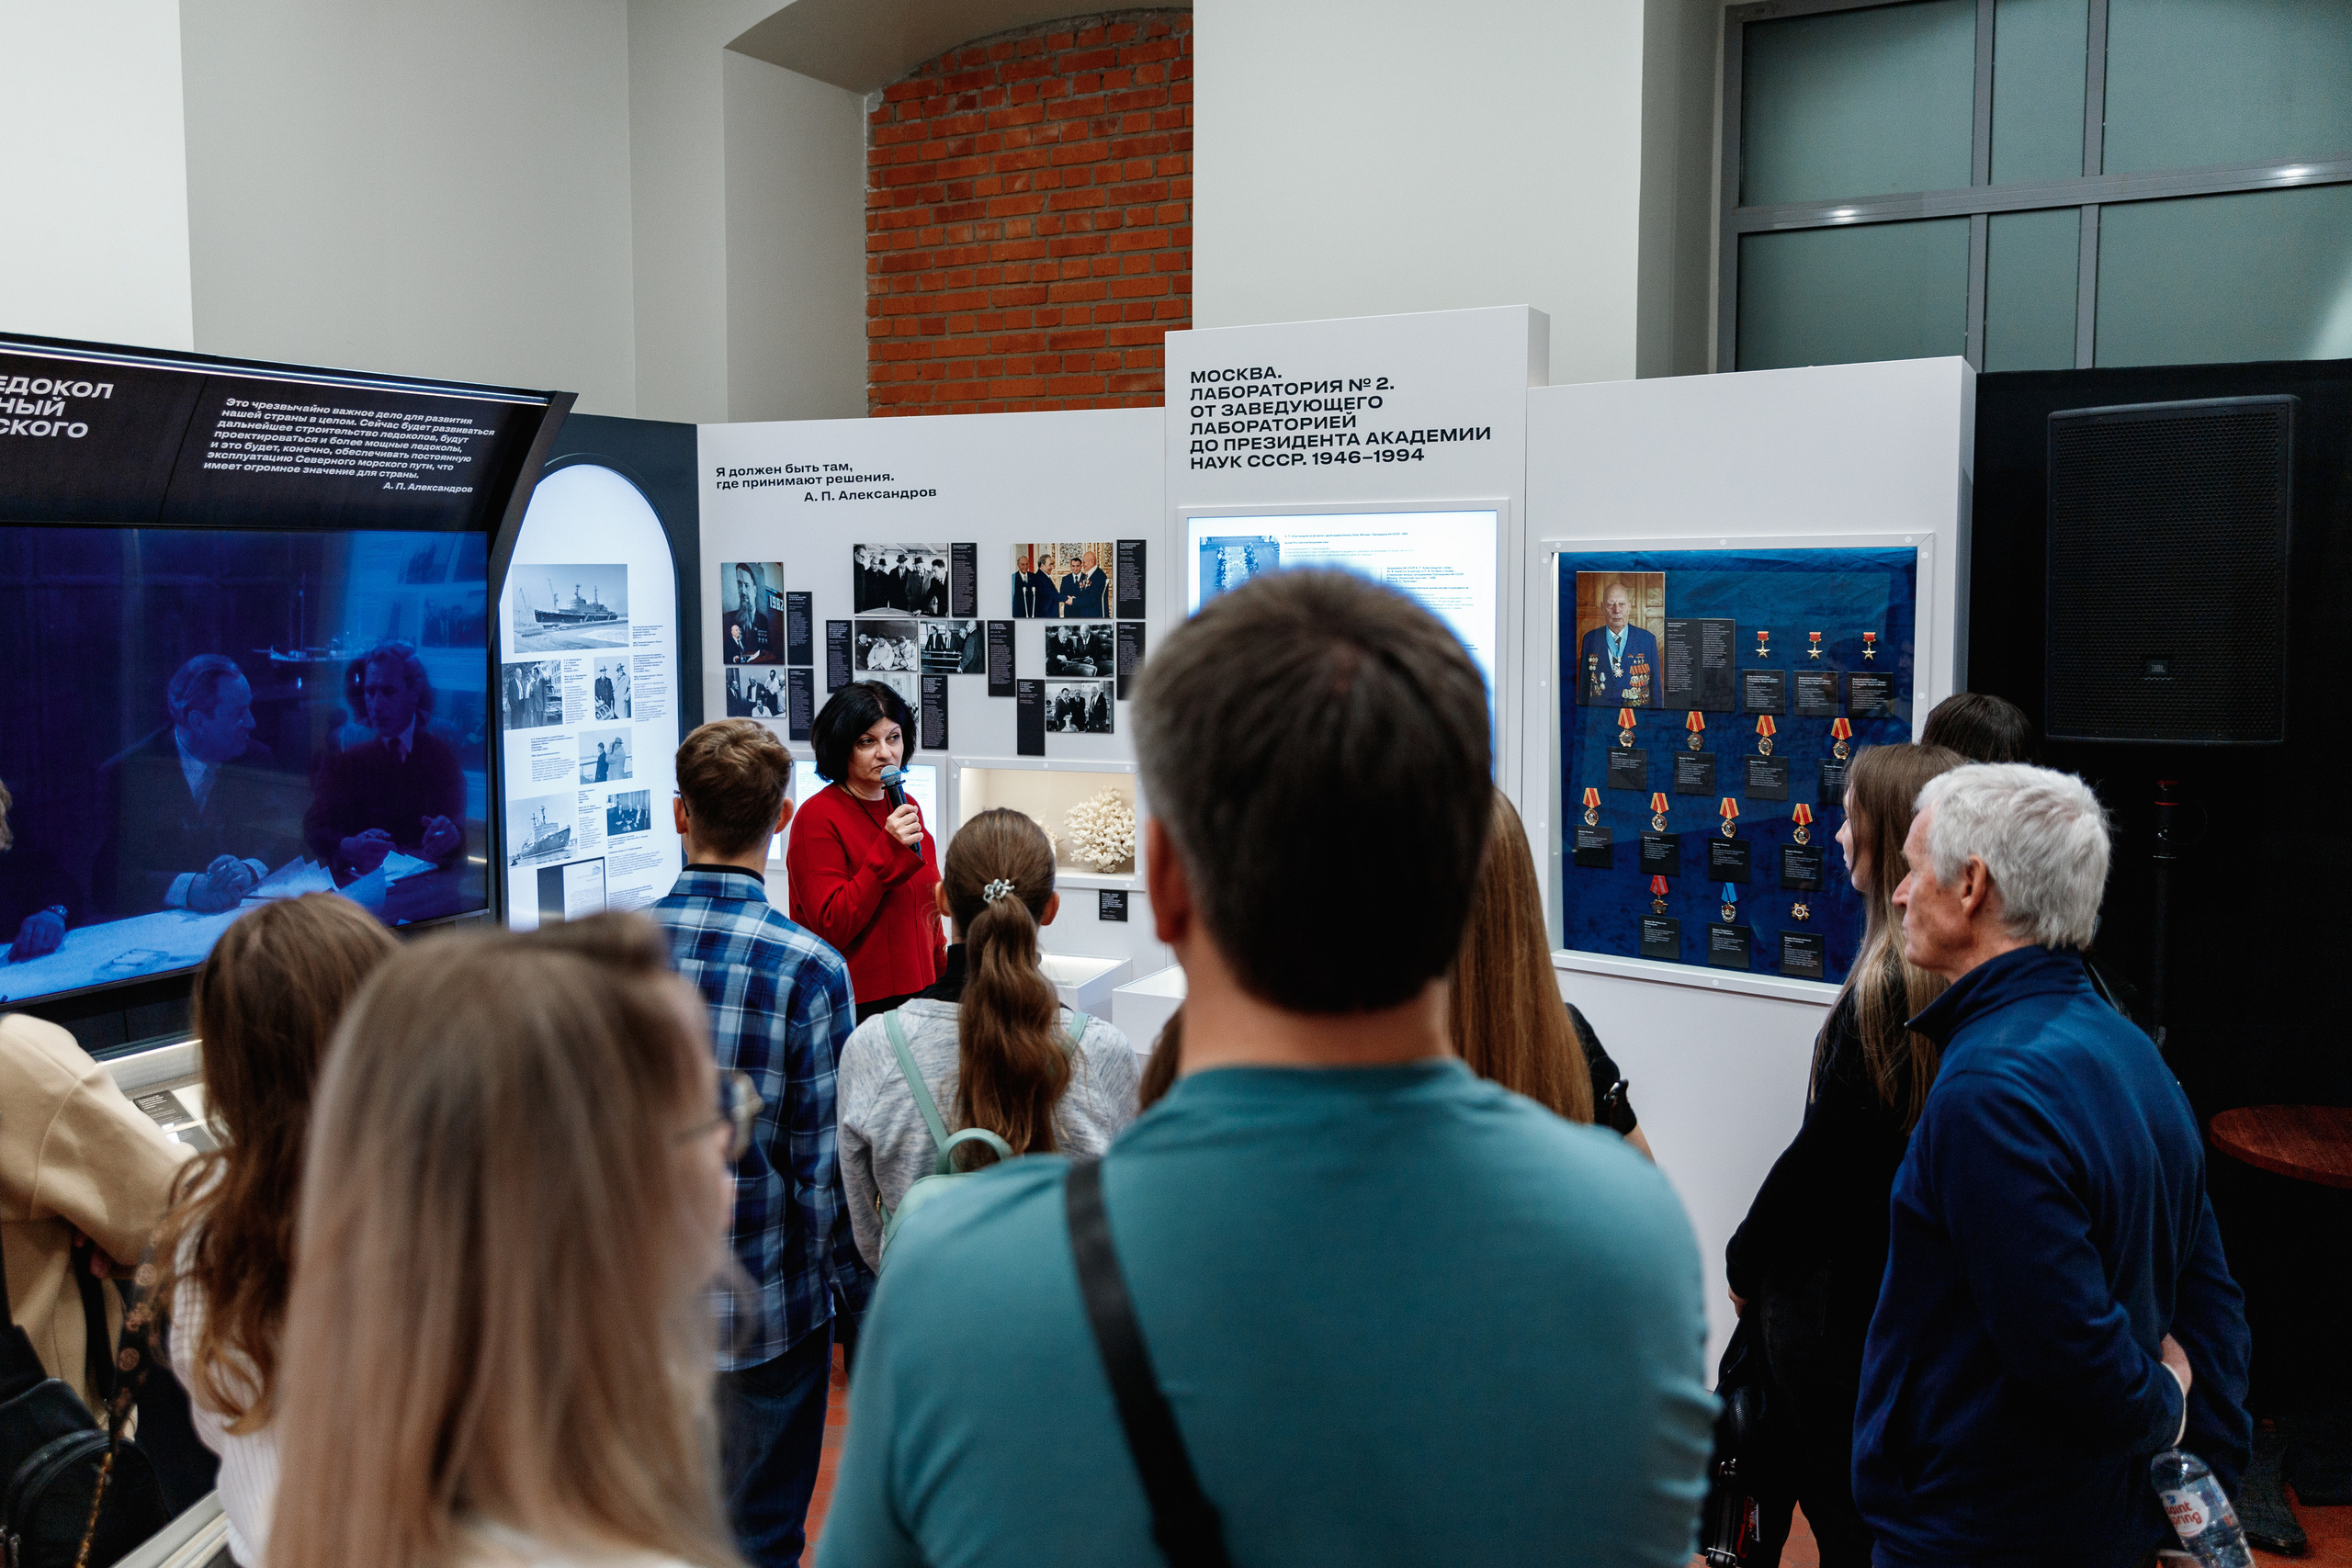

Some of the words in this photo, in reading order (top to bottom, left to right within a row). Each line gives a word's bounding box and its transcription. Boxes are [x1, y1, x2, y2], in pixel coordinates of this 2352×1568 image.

[1190, 367, 1282, 384] МОСКВА.
[1190, 379, 1342, 400] ЛАБОРАТОРИЯ
[1349, 378, 1372, 391] №
[1376, 377, 1395, 390] 2.
[226, 398, 249, 407] Это
[252, 400, 331, 413] чрезвычайно
[333, 408, 374, 417] важное
[403, 413, 423, 422] для
[424, 415, 473, 424] развития
[1190, 405, 1216, 418] ОТ
[1221, 396, 1384, 417] ЗАВЕДУЮЩЕГО
[217, 420, 293, 432] дальнейшее
[295, 425, 379, 437] строительство
[380, 432, 438, 442] ледоколов,
[440, 434, 469, 444] будут
[221, 410, 262, 419] нашей
[264, 413, 307, 423] страны
[319, 417, 356, 425] целом.
[360, 419, 400, 429] Сейчас
[401, 422, 432, 431] будет
[432, 424, 495, 436] развиваться
[1190, 412, 1356, 435] ЛАБОРАТОРИЕЙ
[214, 430, 318, 444] проектироваться
[329, 436, 363, 446] более
[364, 441, 409, 449] мощные
[411, 443, 462, 453] ледоколы,
[1190, 440, 1218, 454] ДО
[1225, 433, 1361, 451] ПРЕЗИДЕНТА
[1365, 427, 1491, 445] АКАДЕМИИ
[207, 450, 293, 462] эксплуатацию
[296, 455, 356, 466] Северного
[357, 460, 408, 468] морского
[244, 443, 280, 452] будет,
[283, 446, 334, 455] конечно,
[335, 447, 409, 458] обеспечивать
[411, 454, 471, 463] постоянную
[1190, 456, 1242, 469] НАУК
[1248, 453, 1306, 468] СССР.
[203, 461, 242, 469] имеет
[243, 464, 300, 473] огромное
[303, 468, 355, 476] значение
[379, 470, 419, 479] страны.
[716, 468, 726, 478] Я
[729, 467, 781, 478] должен
[785, 464, 819, 474] быть
[823, 463, 853, 473] там,
[407, 483, 473, 493] Александров
[717, 479, 739, 491] где
[742, 476, 822, 490] принимают
[826, 473, 895, 486] решения.
[804, 492, 818, 502] А.
[821, 491, 834, 501] П.
[839, 489, 937, 501] Александров
